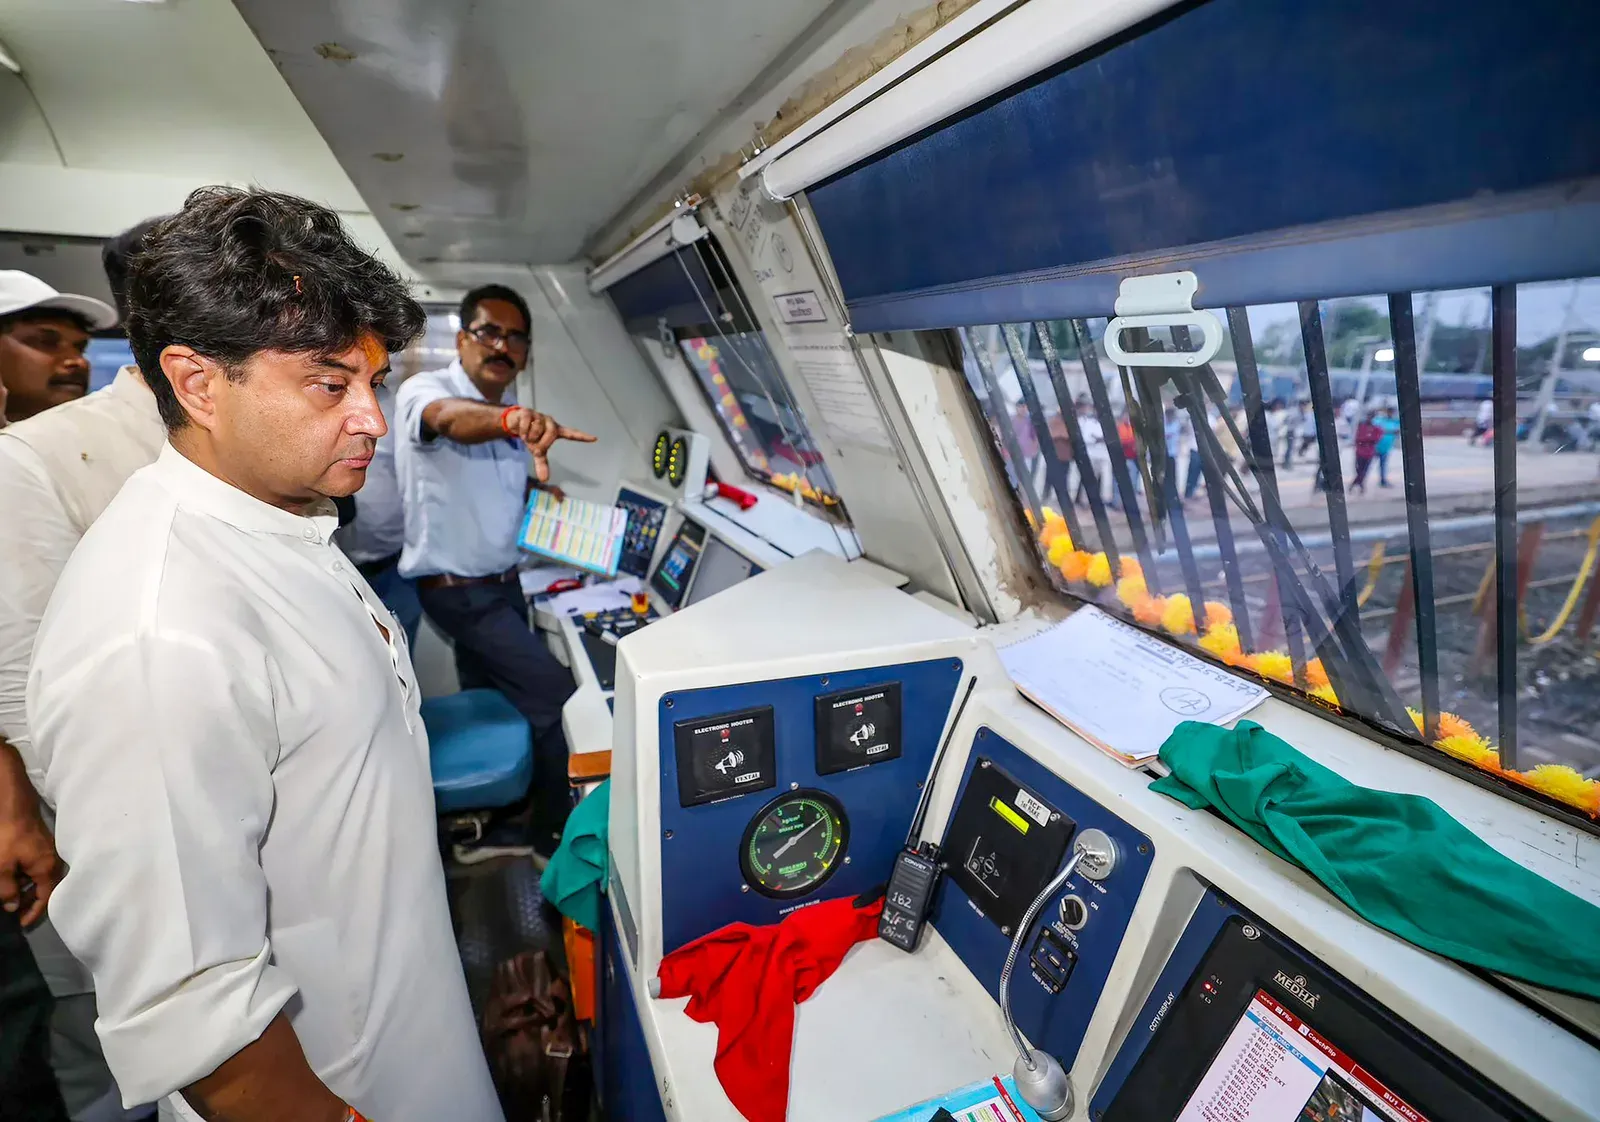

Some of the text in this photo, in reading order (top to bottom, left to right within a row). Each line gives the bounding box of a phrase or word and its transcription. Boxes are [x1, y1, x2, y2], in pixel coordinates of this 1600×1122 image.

[833, 693, 884, 708] ELECTRONIC HOOTER
[694, 718, 754, 734] ELECTRONIC HOOTER
[1066, 881, 1076, 890] OFF
[1090, 901, 1098, 910] ON
[1273, 971, 1316, 1009] MEDHA
[1149, 992, 1176, 1032] CCTV DISPLAY
[1262, 1016, 1284, 1035] Coaches
[1254, 1042, 1278, 1064] BU1_TC1
[1258, 1036, 1285, 1061] BU1_TC1A
[1261, 1032, 1287, 1054] BU1_DMC
[1308, 1032, 1337, 1057] CoachFlip
[1251, 1048, 1274, 1068] BU1_TC2
[1238, 1069, 1260, 1091] BU2_TC1
[1240, 1064, 1267, 1089] BU2_TC1A
[1244, 1058, 1270, 1082] BU2_DMC
[1248, 1052, 1286, 1087] BU2_DMC_EXT
[1234, 1074, 1258, 1096] BU2_TC2
[1220, 1096, 1245, 1120] BU3_DMC
[1224, 1090, 1250, 1116] BU3_TC1A
